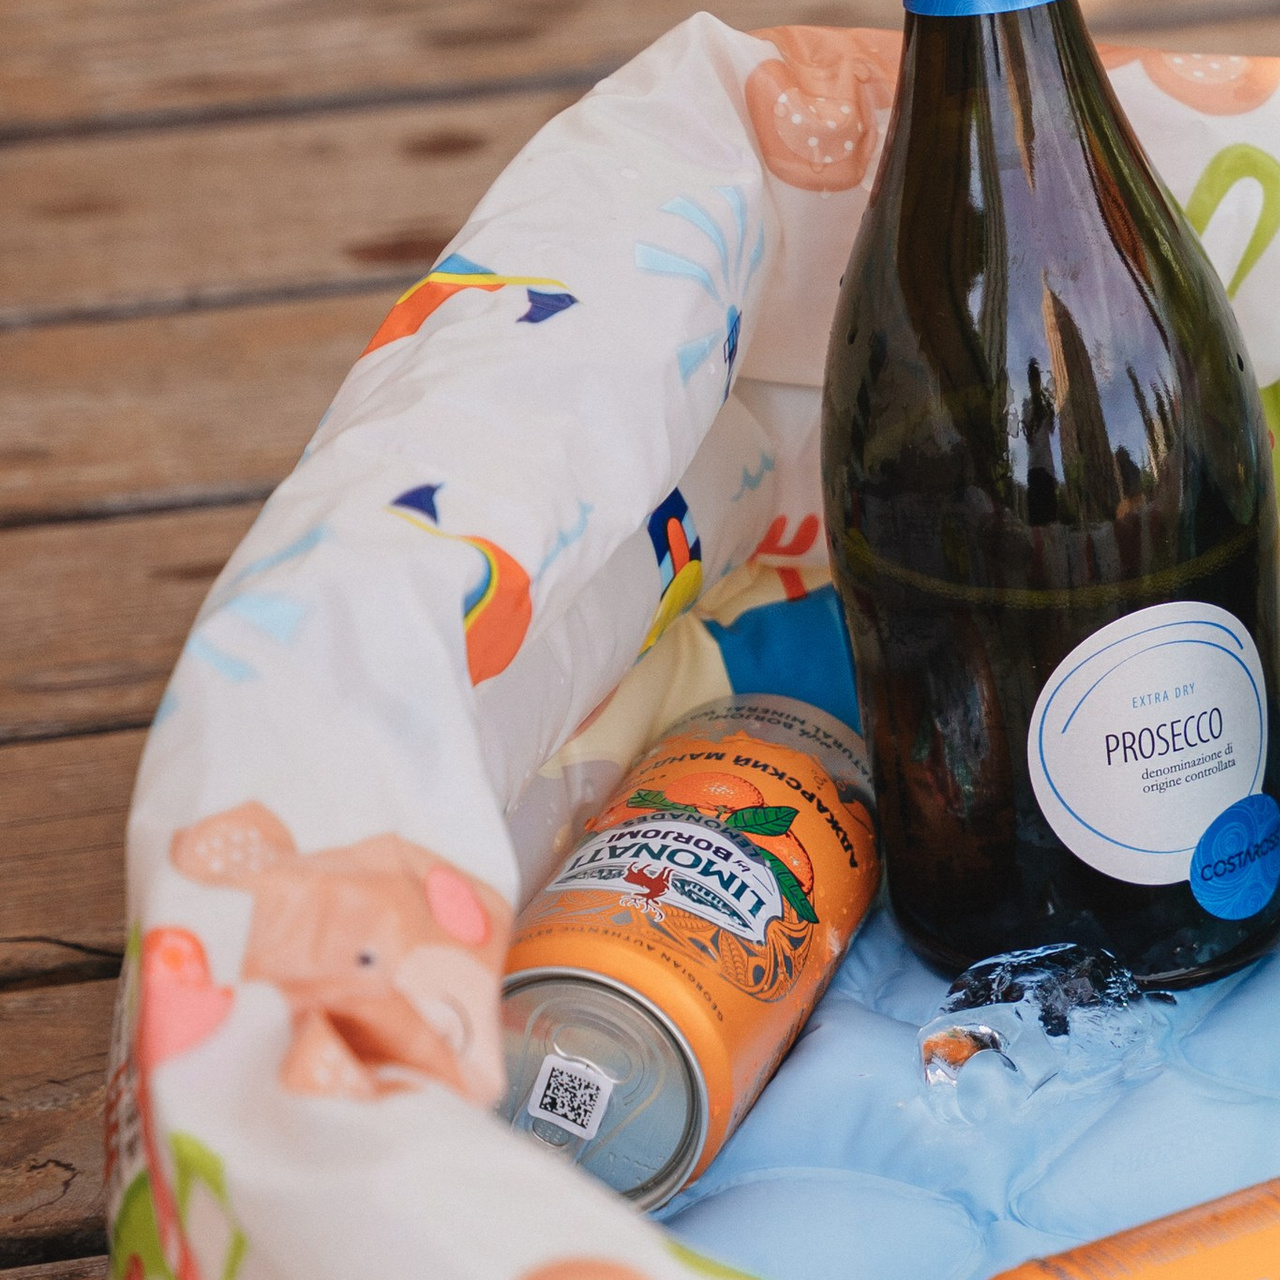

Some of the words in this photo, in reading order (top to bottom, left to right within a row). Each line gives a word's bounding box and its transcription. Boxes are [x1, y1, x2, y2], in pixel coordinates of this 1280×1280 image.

[1131, 690, 1170, 709] EXTRA
[1174, 682, 1196, 699] DRY
[1105, 706, 1223, 766] PROSECCO
[1141, 749, 1222, 781] denominazione
[1224, 741, 1234, 758] di
[1142, 776, 1182, 794] origine
[1184, 758, 1237, 784] controllata
[731, 754, 859, 869] АДЖАРСКИЙ
[606, 828, 733, 861] BORJOMI
[622, 811, 761, 859] LEMONADES
[568, 841, 768, 920] LIMONATI
[732, 859, 751, 873] by
[660, 951, 724, 1022] GEORGIAN
